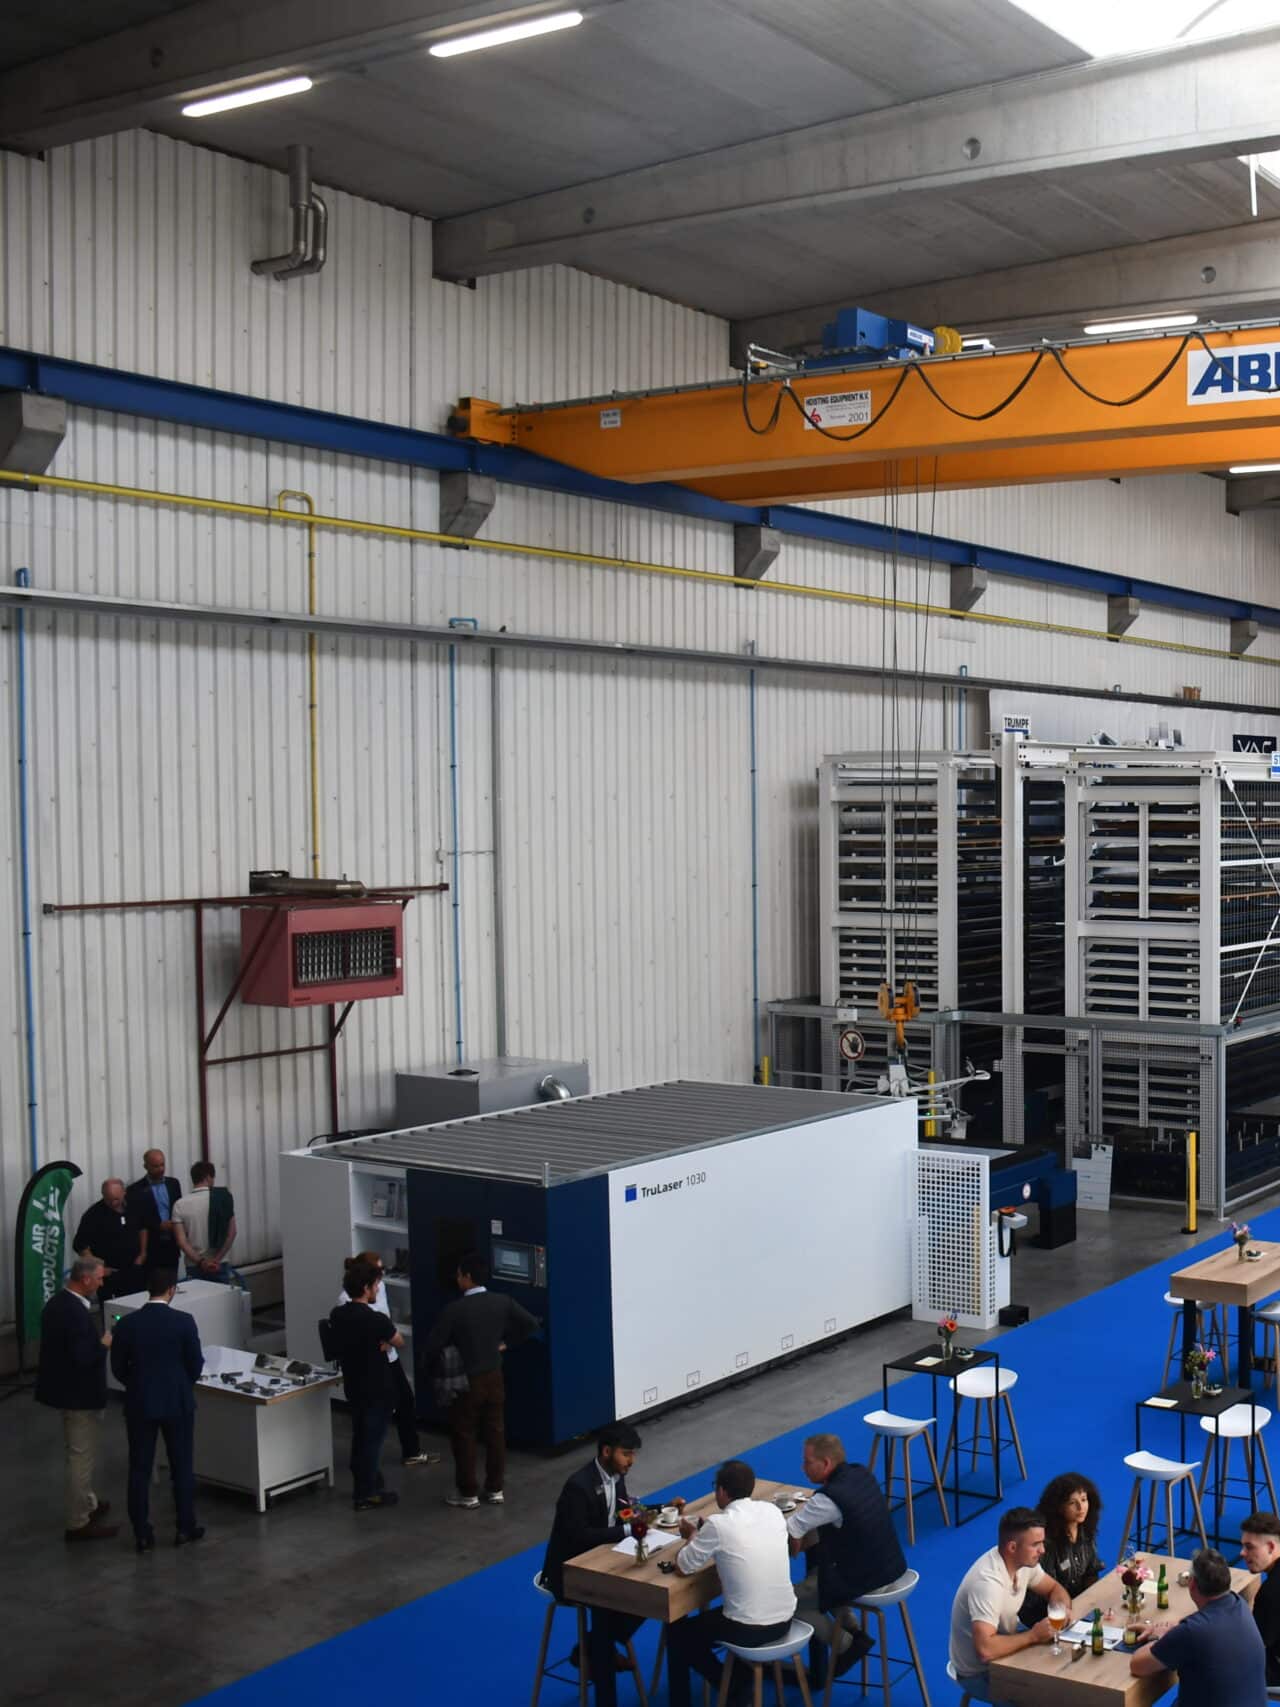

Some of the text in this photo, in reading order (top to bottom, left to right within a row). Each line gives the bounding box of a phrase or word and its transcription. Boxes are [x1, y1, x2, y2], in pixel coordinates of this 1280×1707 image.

[849, 411, 869, 423] 2001
[1004, 717, 1029, 728] TRUMPF
[641, 1172, 706, 1198] TruLaser 1030
[32, 1224, 46, 1255] AIR
[42, 1224, 60, 1303] RODUCTS
